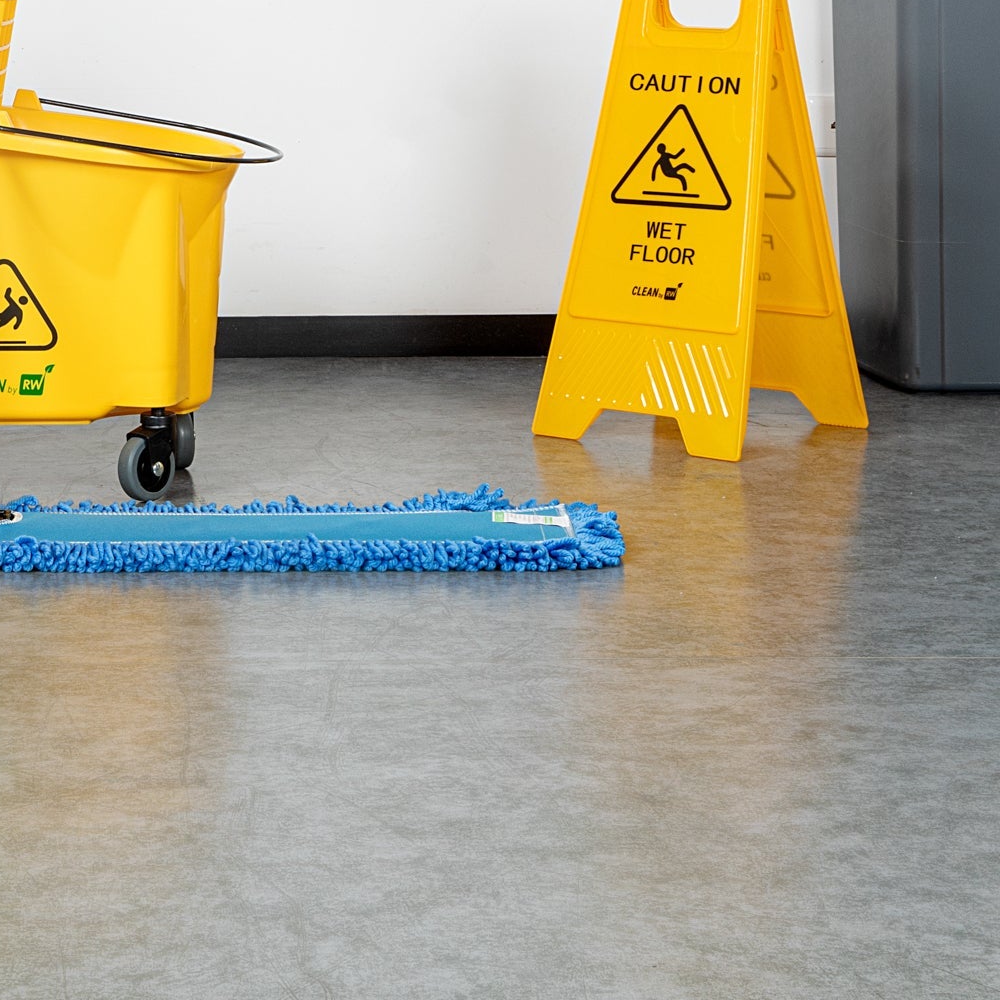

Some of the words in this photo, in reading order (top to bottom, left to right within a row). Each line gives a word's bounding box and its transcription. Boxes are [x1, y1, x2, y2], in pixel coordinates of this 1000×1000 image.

[629, 73, 741, 95] CAUTION
[646, 221, 687, 240] WET
[629, 244, 695, 265] FLOOR
[631, 285, 659, 297] CLEAN
[8, 386, 18, 396] by
[22, 378, 44, 391] RW
